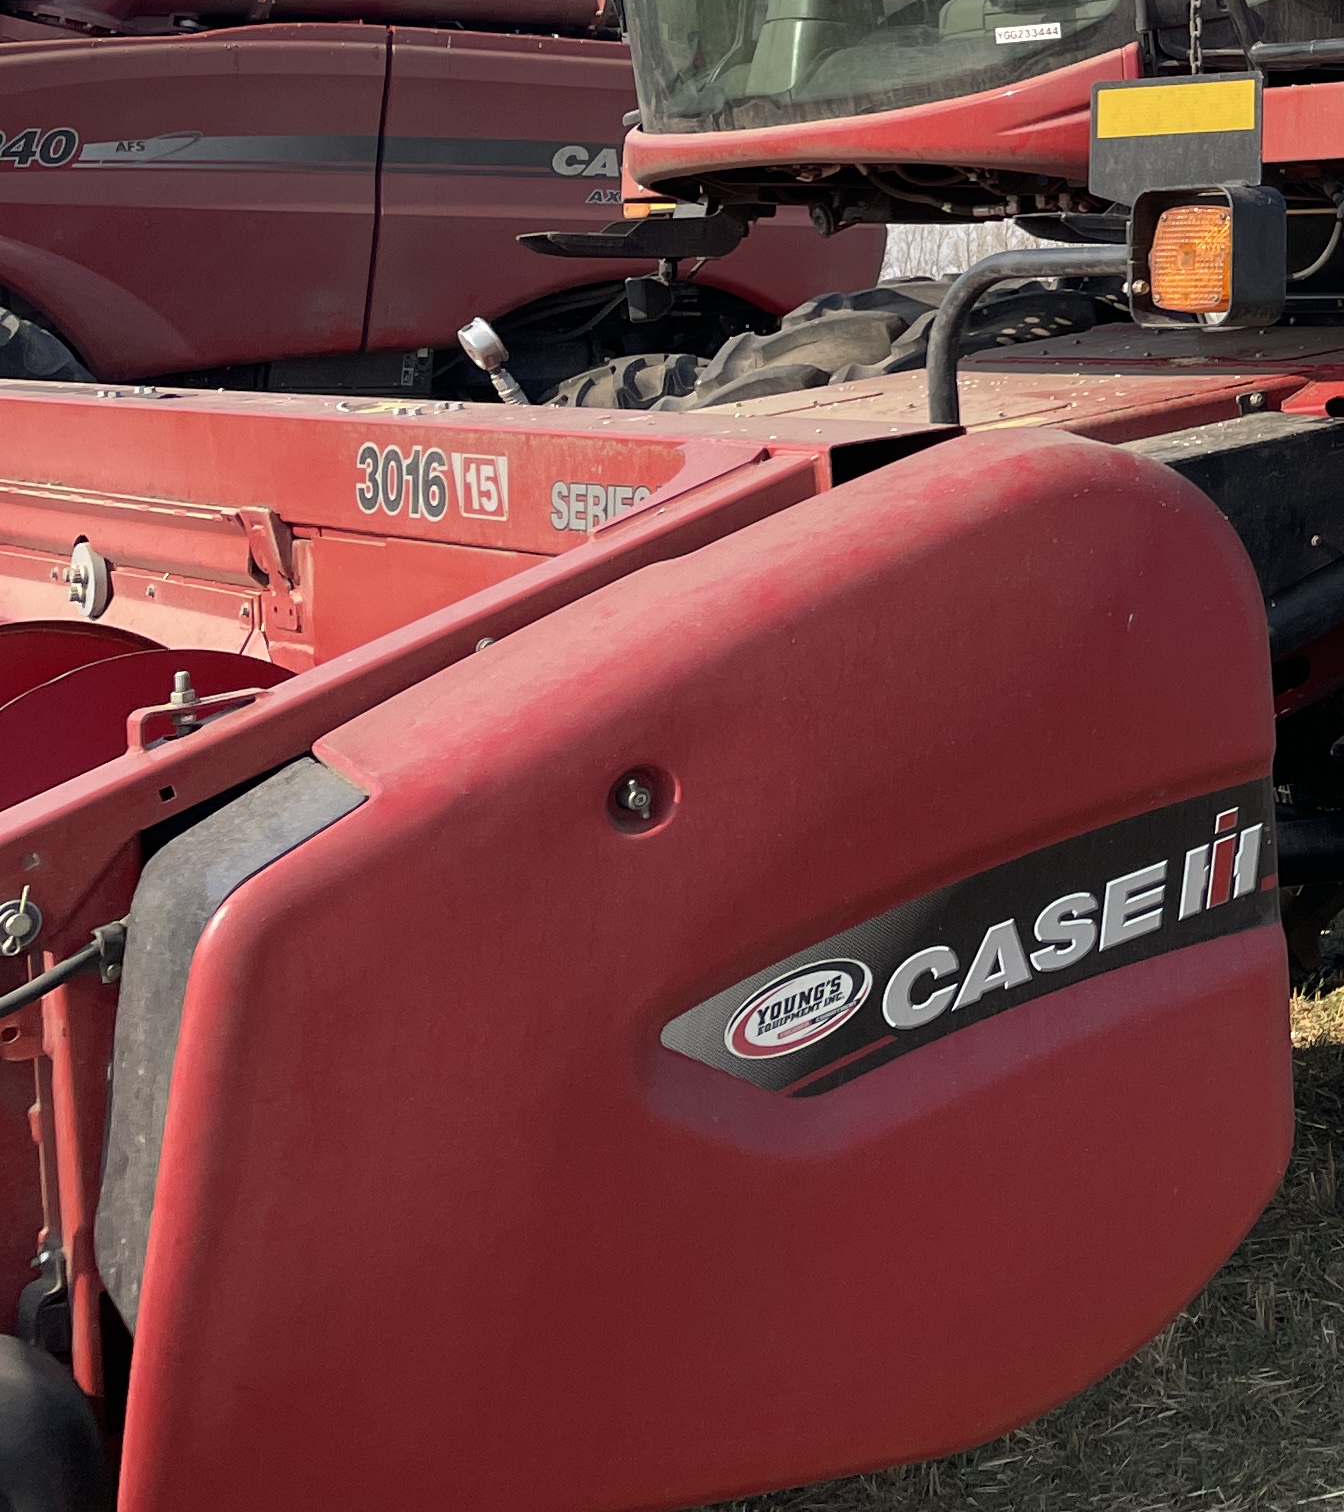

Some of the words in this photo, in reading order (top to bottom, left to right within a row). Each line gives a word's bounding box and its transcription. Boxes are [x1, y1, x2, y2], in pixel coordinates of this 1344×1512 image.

[0, 126, 79, 169] 40
[115, 141, 146, 153] AFS
[552, 144, 621, 178] CA
[356, 441, 448, 522] 3016
[466, 462, 499, 512] 15
[882, 859, 1168, 1030] CASE
[1177, 806, 1263, 921] IH
[756, 1000, 822, 1037] EQUIPMENT
[757, 974, 842, 1027] YOUNG'S
